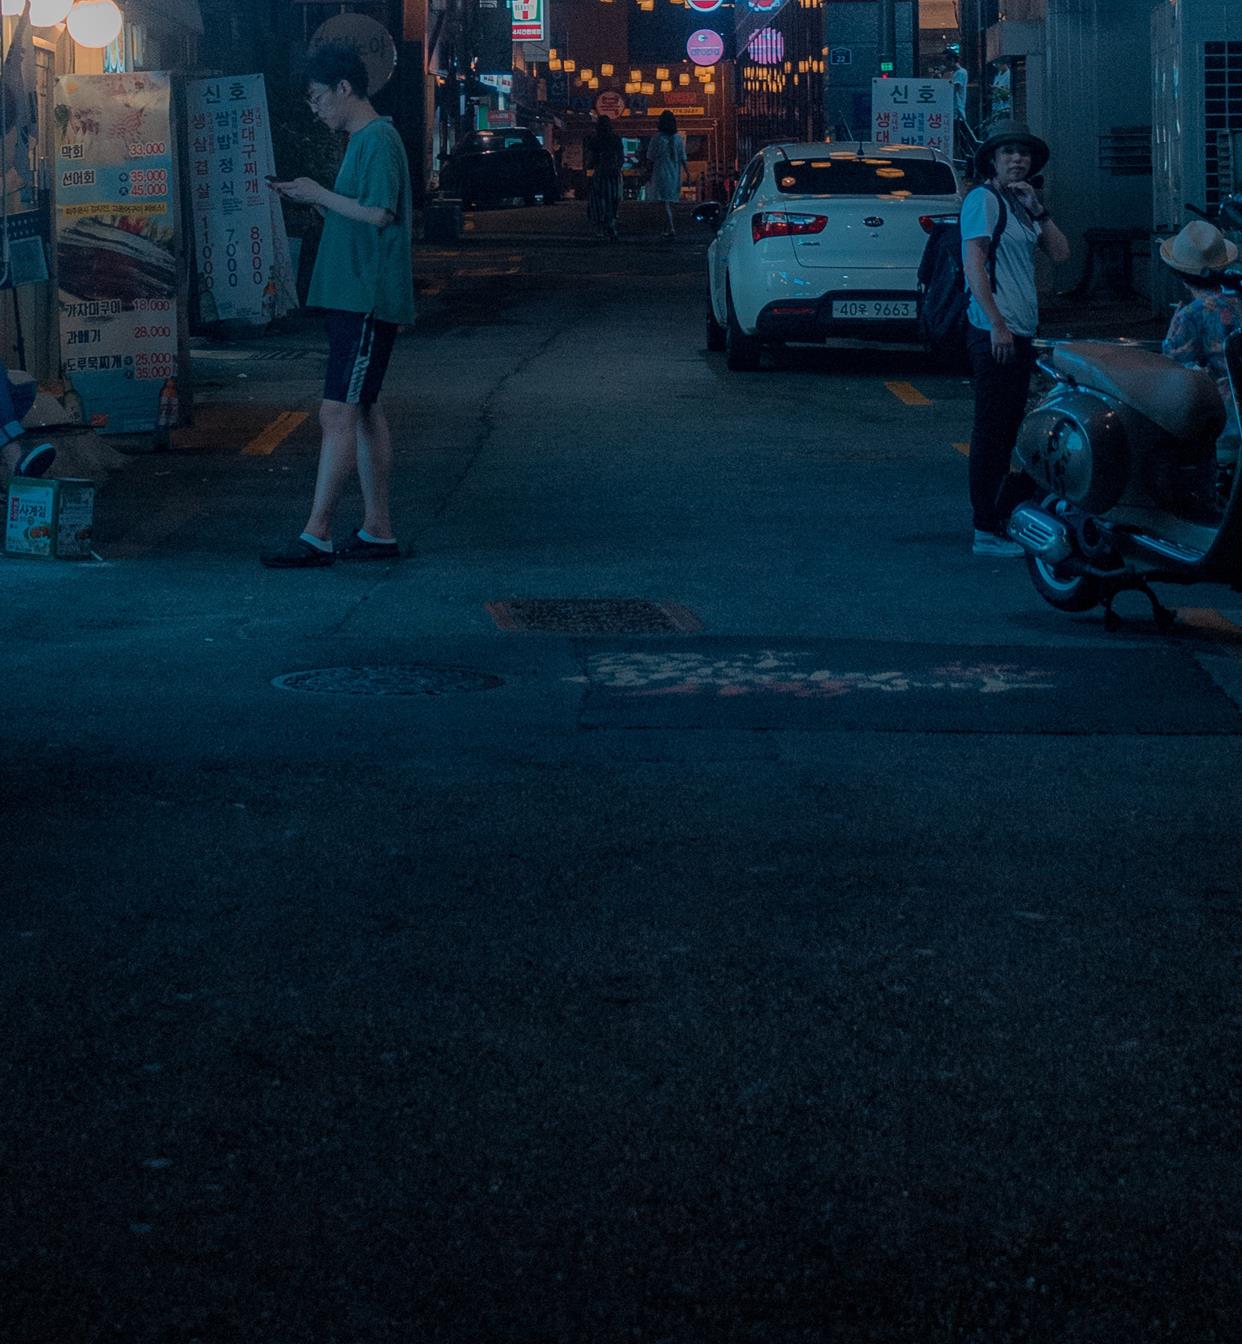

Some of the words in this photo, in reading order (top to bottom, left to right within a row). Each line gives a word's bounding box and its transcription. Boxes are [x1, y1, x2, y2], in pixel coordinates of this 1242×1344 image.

[890, 84, 937, 105] 신호
[62, 145, 83, 159] 막회
[63, 170, 94, 186] 선어회
[65, 301, 121, 317] 가자미구이
[839, 302, 868, 317] 40우
[873, 302, 911, 317] 9663
